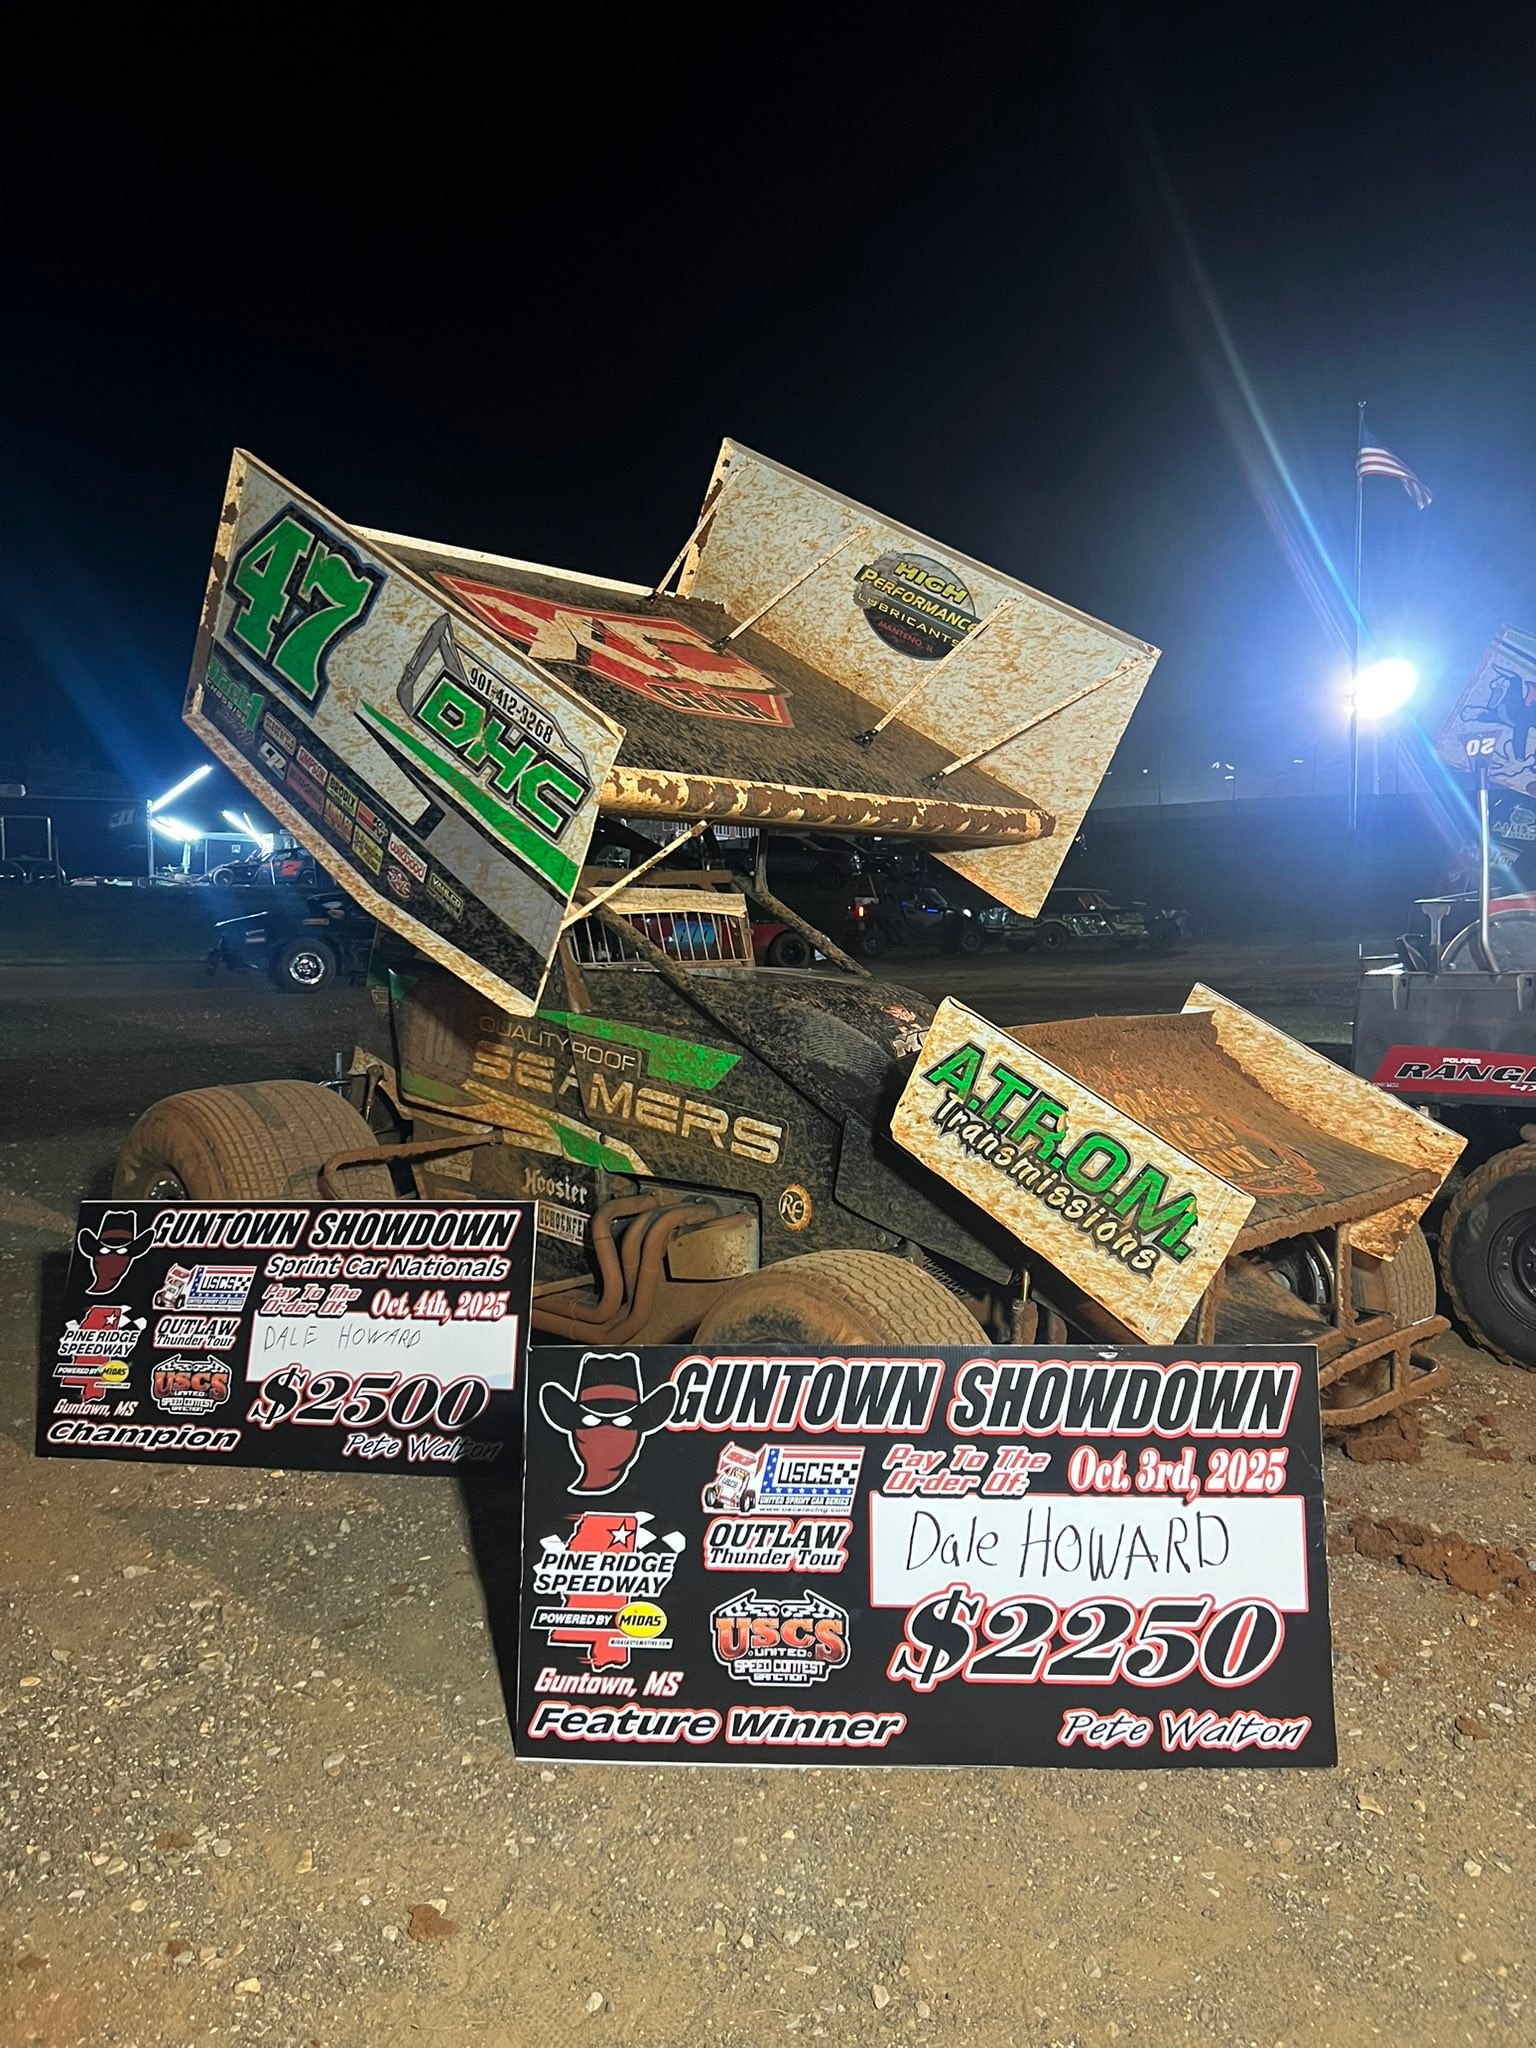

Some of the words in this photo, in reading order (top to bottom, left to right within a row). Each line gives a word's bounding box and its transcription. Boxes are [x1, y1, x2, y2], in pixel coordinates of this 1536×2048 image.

[894, 561, 968, 604] HIGH
[230, 511, 378, 704] 47
[860, 568, 977, 632] PERFORMANCE
[858, 593, 961, 648] LUBRICANTS
[879, 620, 924, 648] MANTENO,
[469, 667, 554, 745] 901-412-3268
[416, 675, 587, 835] DHC
[330, 776, 355, 811] BRODIX
[480, 1015, 569, 1051] QUALITY
[571, 1041, 636, 1070] ROOF
[1442, 1057, 1481, 1065] POLARIS
[520, 1166, 589, 1205] Hoosier
[934, 1092, 1158, 1273] Transmissions
[151, 1209, 309, 1248] GUNTOWN
[311, 1209, 520, 1249] SHOWDOWN
[266, 1255, 341, 1279] Sprint
[346, 1256, 387, 1277] Car
[389, 1256, 510, 1279] Nationals
[200, 1276, 235, 1291] USCS
[263, 1284, 300, 1302] Pay
[302, 1286, 325, 1300] To
[328, 1285, 361, 1301] The
[260, 1299, 319, 1316] Order
[411, 1290, 451, 1324] 4th,
[454, 1291, 510, 1318] 2025
[64, 1330, 96, 1342] PINE
[96, 1331, 139, 1343] RIDGE
[157, 1318, 238, 1336] OUTLAW
[157, 1334, 204, 1346] Thunder
[207, 1335, 233, 1347] Tour
[263, 1324, 318, 1352] DALE
[338, 1323, 422, 1350] HOWARD
[59, 1343, 133, 1356] SPEEDWAY
[57, 1367, 88, 1375] POWERED
[154, 1371, 228, 1401] USCS
[247, 1365, 491, 1428] $2500
[670, 1360, 941, 1430] GUNTOWN
[951, 1361, 1299, 1437] SHOWDOWN
[53, 1399, 111, 1417] Guntown,
[113, 1401, 139, 1416] MS
[48, 1422, 240, 1450] Champion
[344, 1434, 400, 1457] Pete
[407, 1433, 503, 1461] Walton
[883, 1444, 947, 1473] Pay
[952, 1447, 990, 1470] To
[995, 1446, 1050, 1473] The
[777, 1462, 835, 1485] USCS
[884, 1471, 979, 1494] Order
[1138, 1446, 1200, 1501] 3rd,
[1205, 1447, 1289, 1493] 2025
[760, 1497, 784, 1505] UNITED
[785, 1497, 810, 1505] SPRINT
[811, 1497, 824, 1505] CAR
[825, 1497, 850, 1506] SERIES
[709, 1523, 847, 1549] OUTLAW
[906, 1510, 998, 1571] Dale
[1019, 1507, 1230, 1581] HOWARD
[542, 1553, 597, 1571] PINE
[601, 1555, 674, 1573] RIDGE
[711, 1548, 790, 1565] Thunder
[798, 1549, 842, 1566] Tour
[536, 1573, 668, 1594] SPEEDWAY
[538, 1612, 595, 1625] POWERED
[595, 1615, 612, 1626] BY
[619, 1615, 662, 1627] MIDAS
[716, 1617, 846, 1663] USCS
[889, 1585, 1284, 1688] $2250
[755, 1648, 807, 1657] UNITED
[734, 1659, 772, 1673] SPEED
[773, 1660, 825, 1675] CONTEST
[753, 1673, 807, 1681] SANCTION
[534, 1667, 638, 1698] Guntown,
[642, 1671, 684, 1697] MS
[532, 1705, 718, 1741] Feature
[730, 1709, 904, 1746] Winner
[1060, 1711, 1151, 1747] Pete
[1162, 1710, 1310, 1749] Walton
